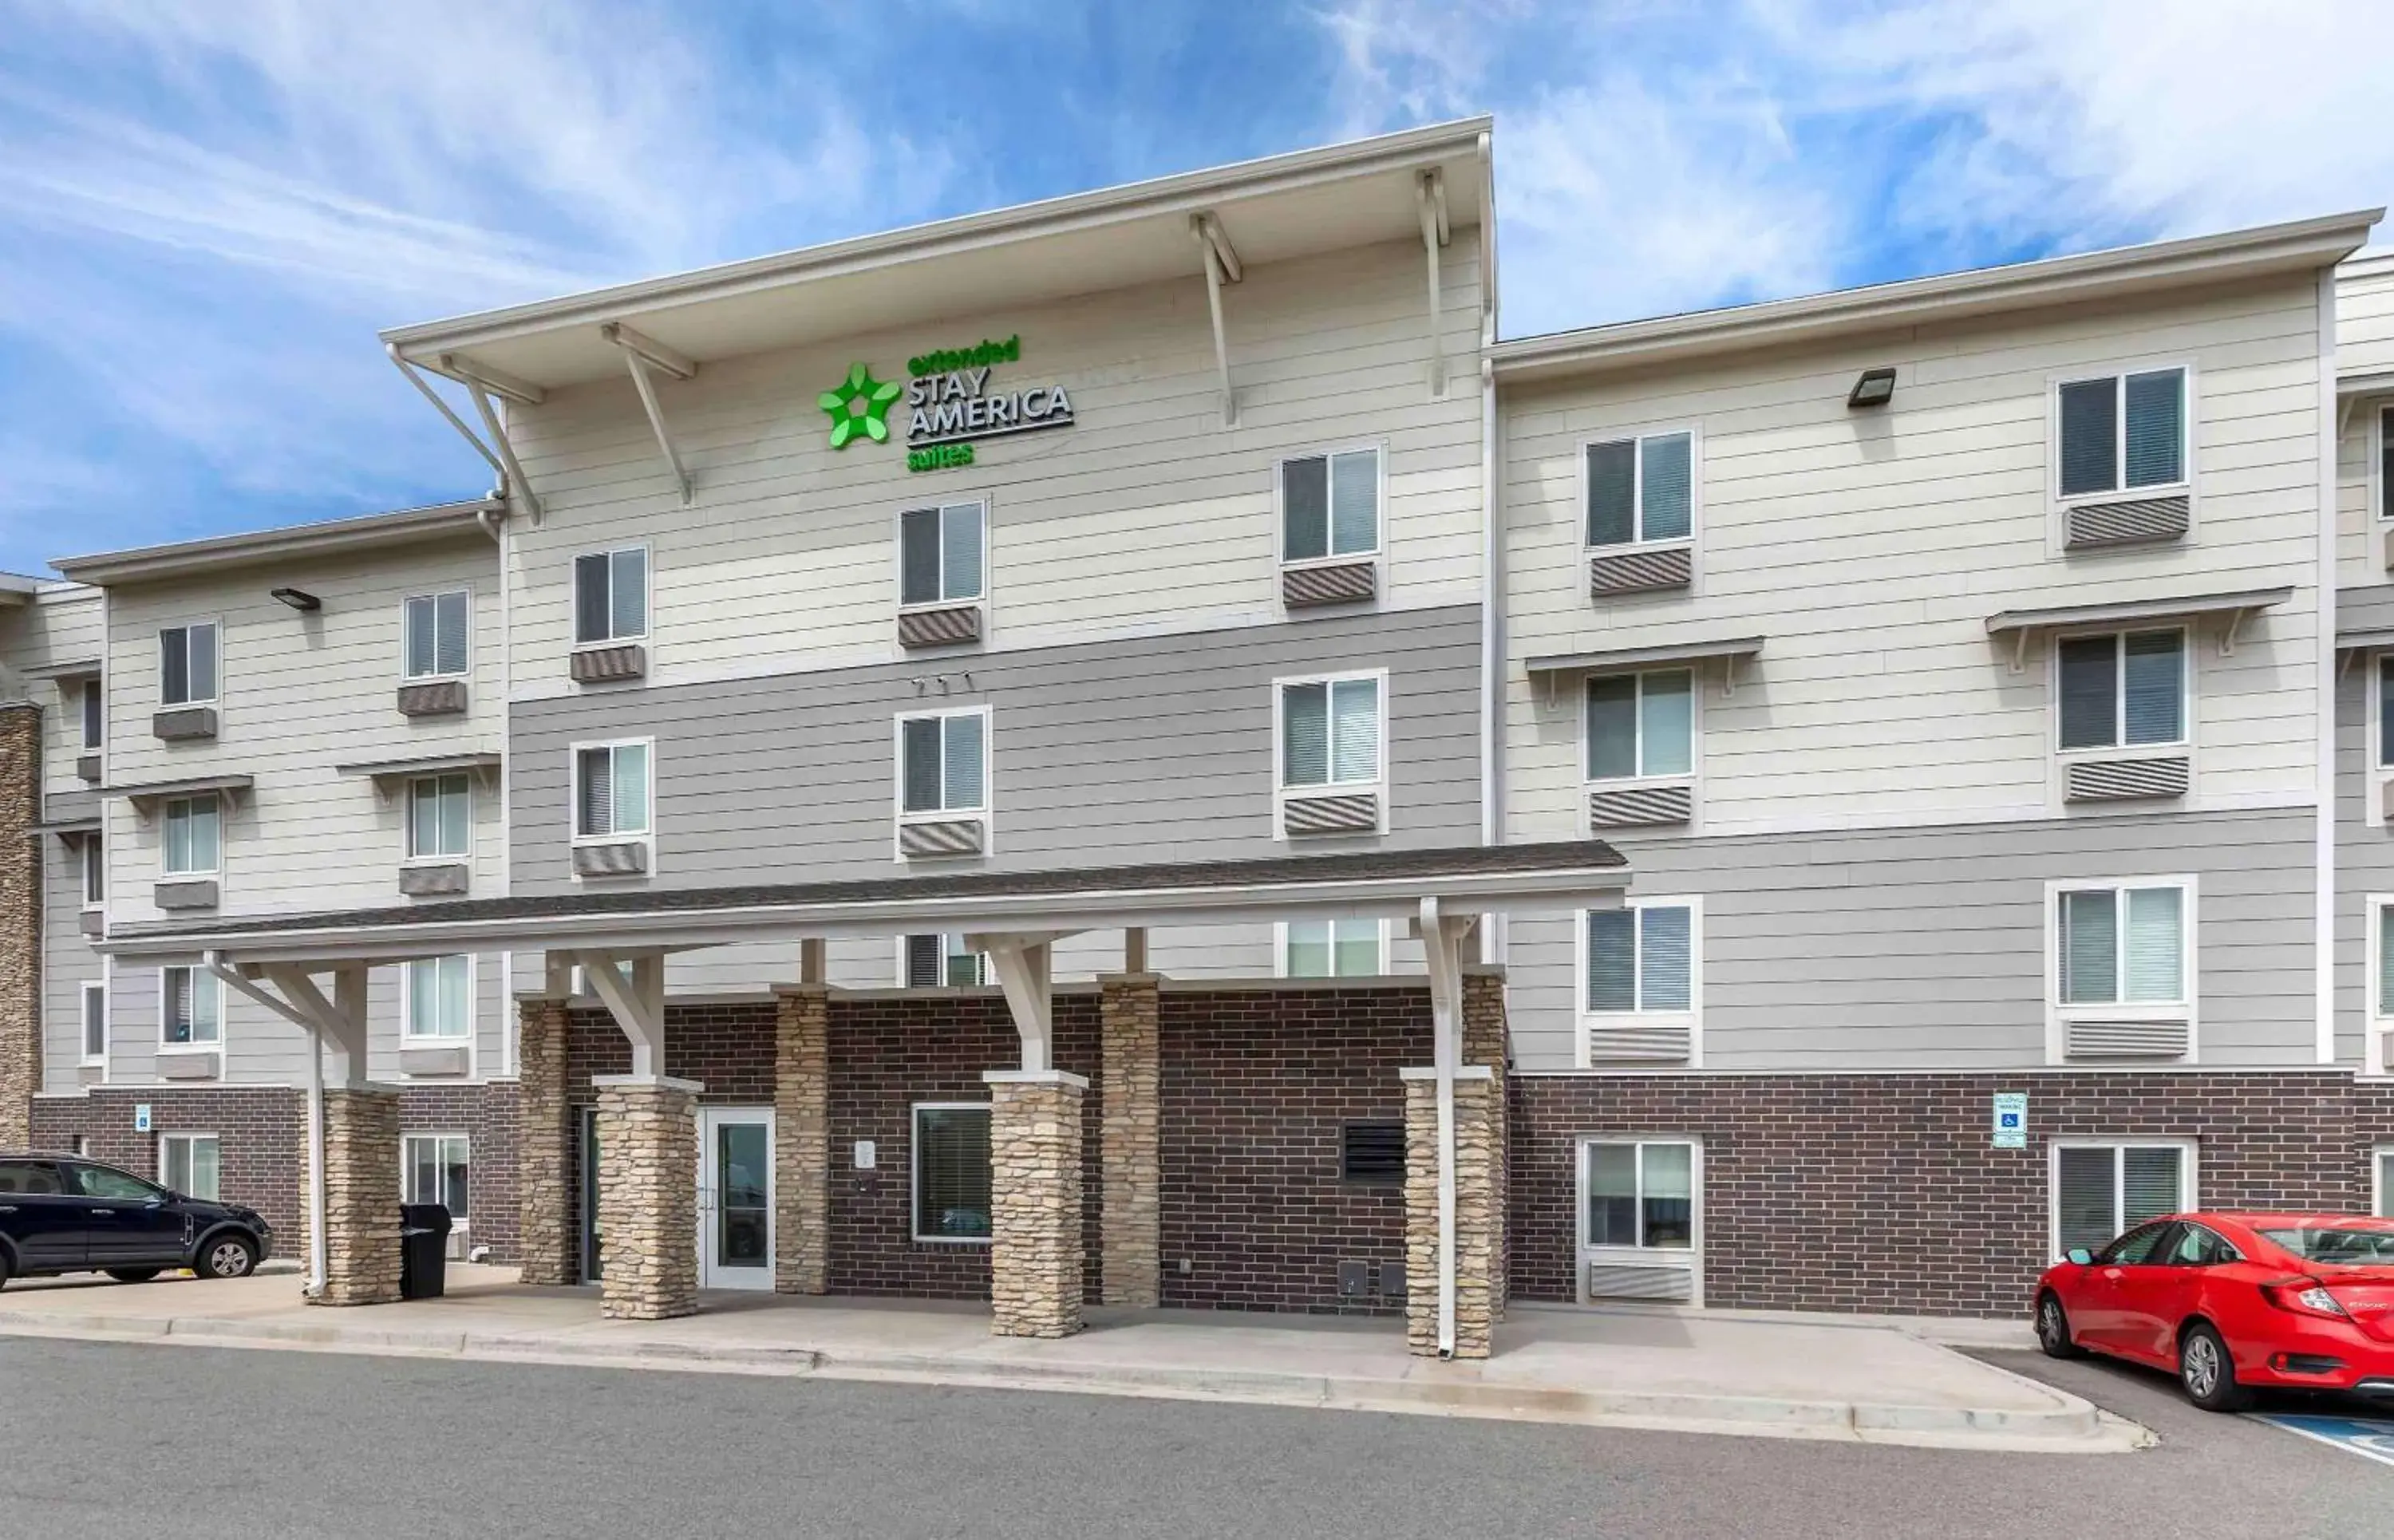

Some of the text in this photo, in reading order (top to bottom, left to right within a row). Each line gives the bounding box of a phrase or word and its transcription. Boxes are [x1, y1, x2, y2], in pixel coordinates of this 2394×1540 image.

[907, 334, 1021, 377] extended
[908, 366, 992, 406] STAY
[907, 385, 1074, 438] AMERICA
[908, 444, 974, 472] suites
